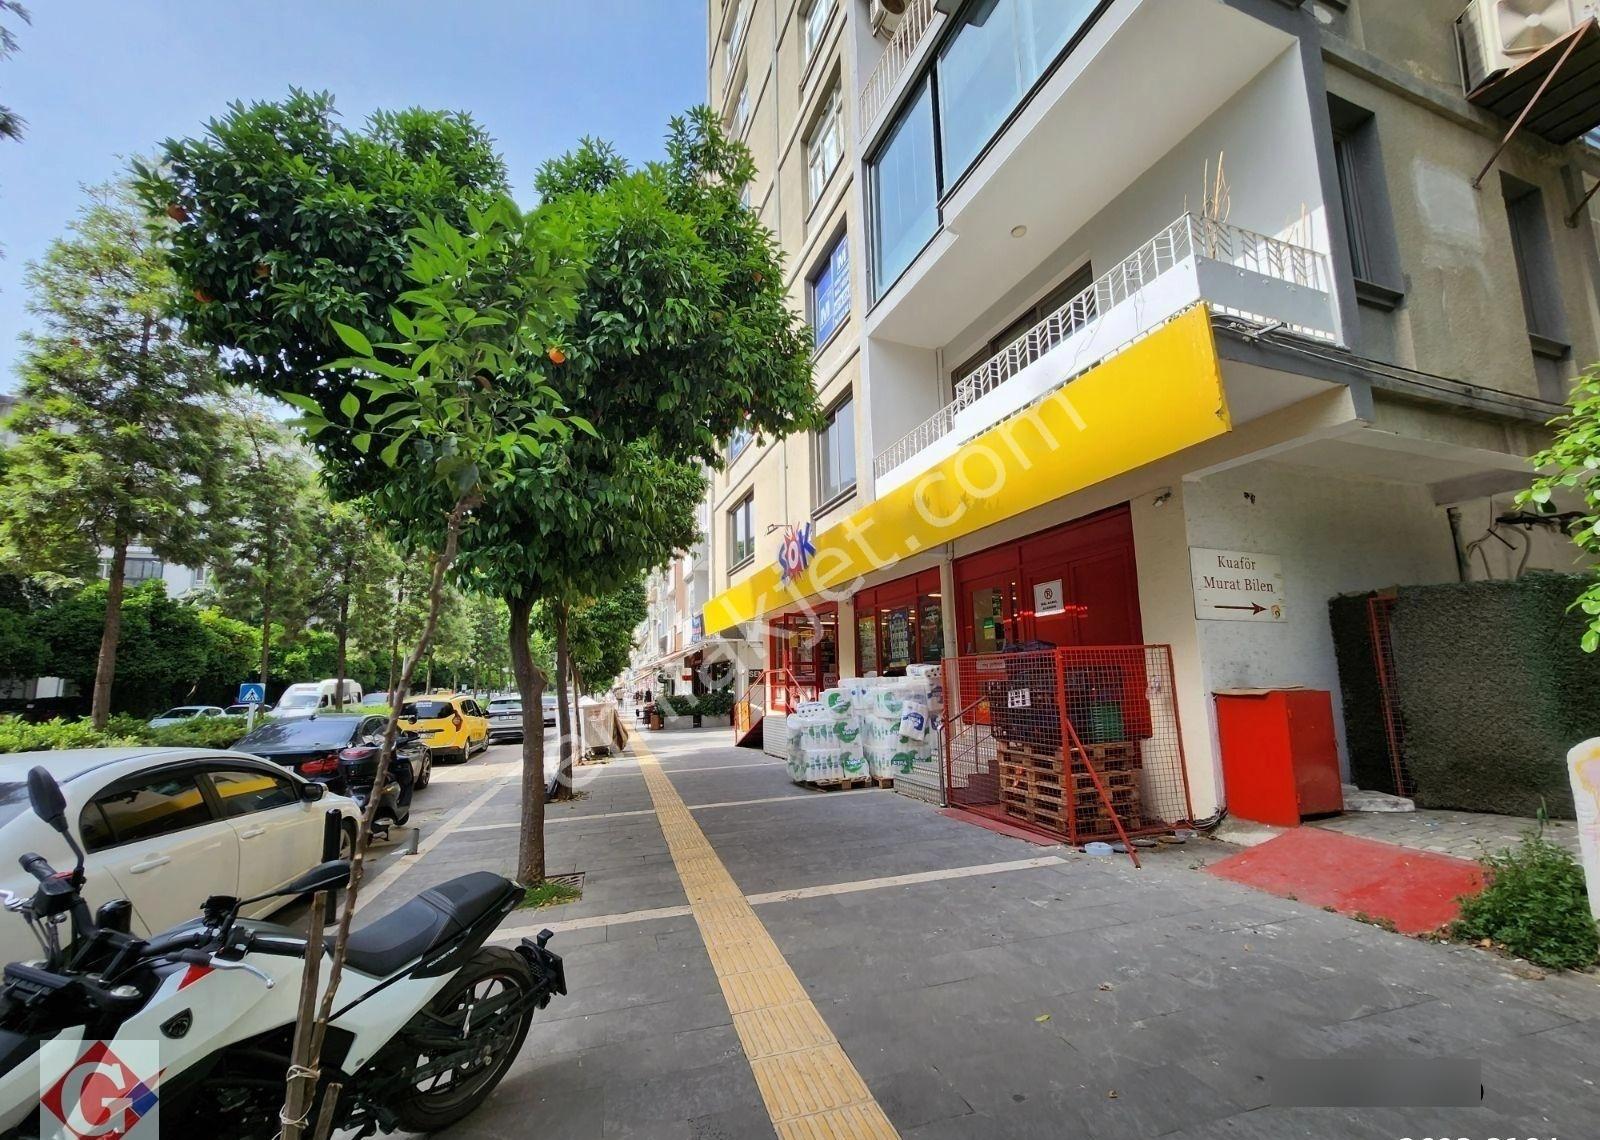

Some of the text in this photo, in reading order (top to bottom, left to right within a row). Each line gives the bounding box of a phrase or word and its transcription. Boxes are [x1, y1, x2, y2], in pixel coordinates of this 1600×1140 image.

[1217, 555, 1256, 571] Kuaför
[1203, 576, 1275, 593] Murat Bilen
